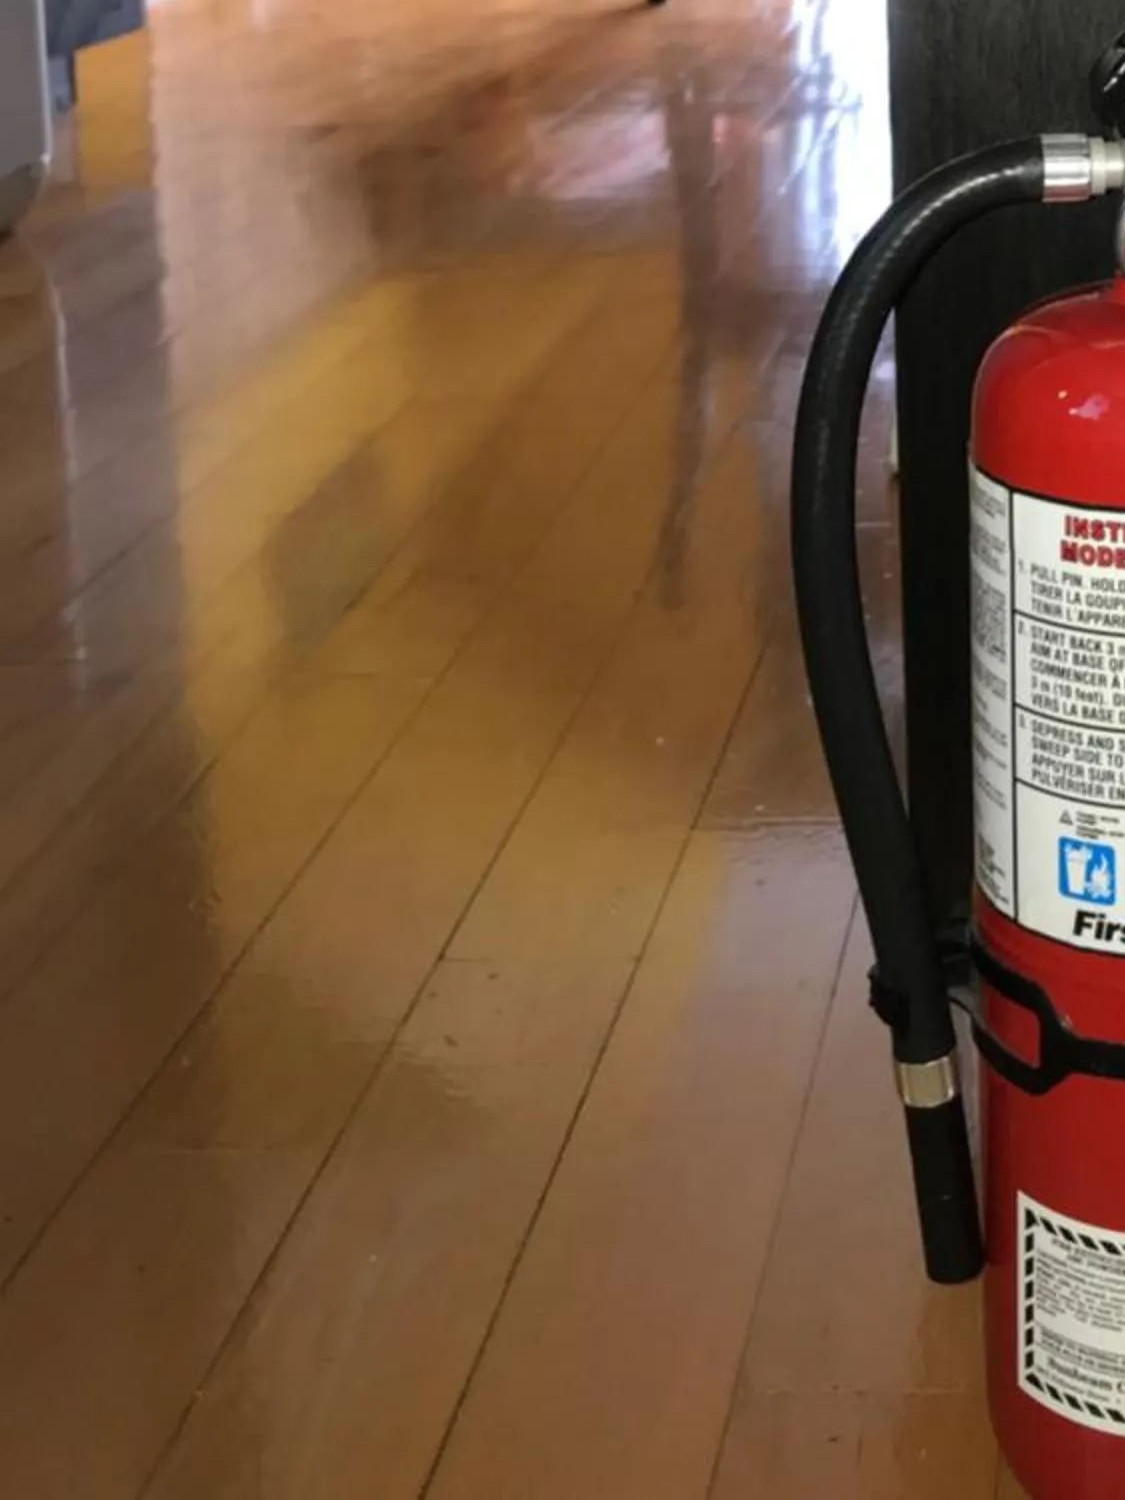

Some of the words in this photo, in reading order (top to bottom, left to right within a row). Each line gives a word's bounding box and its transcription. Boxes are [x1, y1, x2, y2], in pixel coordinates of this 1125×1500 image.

[1030, 562, 1057, 582] PULL
[1031, 580, 1062, 599] TIRER
[1066, 589, 1081, 604] LA
[1031, 598, 1062, 618] TENIR
[1030, 624, 1065, 647] START
[1069, 635, 1102, 652] BACK
[1106, 641, 1115, 655] 3
[1031, 640, 1051, 658] AIM
[1054, 647, 1069, 663] AT
[1072, 652, 1105, 670] BASE
[1108, 658, 1125, 672] OF
[1030, 657, 1107, 688] COMMENCER
[1062, 701, 1078, 717] LA
[1081, 705, 1114, 723] BASE
[1087, 733, 1115, 751] AND
[1031, 752, 1084, 778] APPUYER
[1087, 766, 1116, 782] SUR
[1107, 752, 1124, 768] TO
